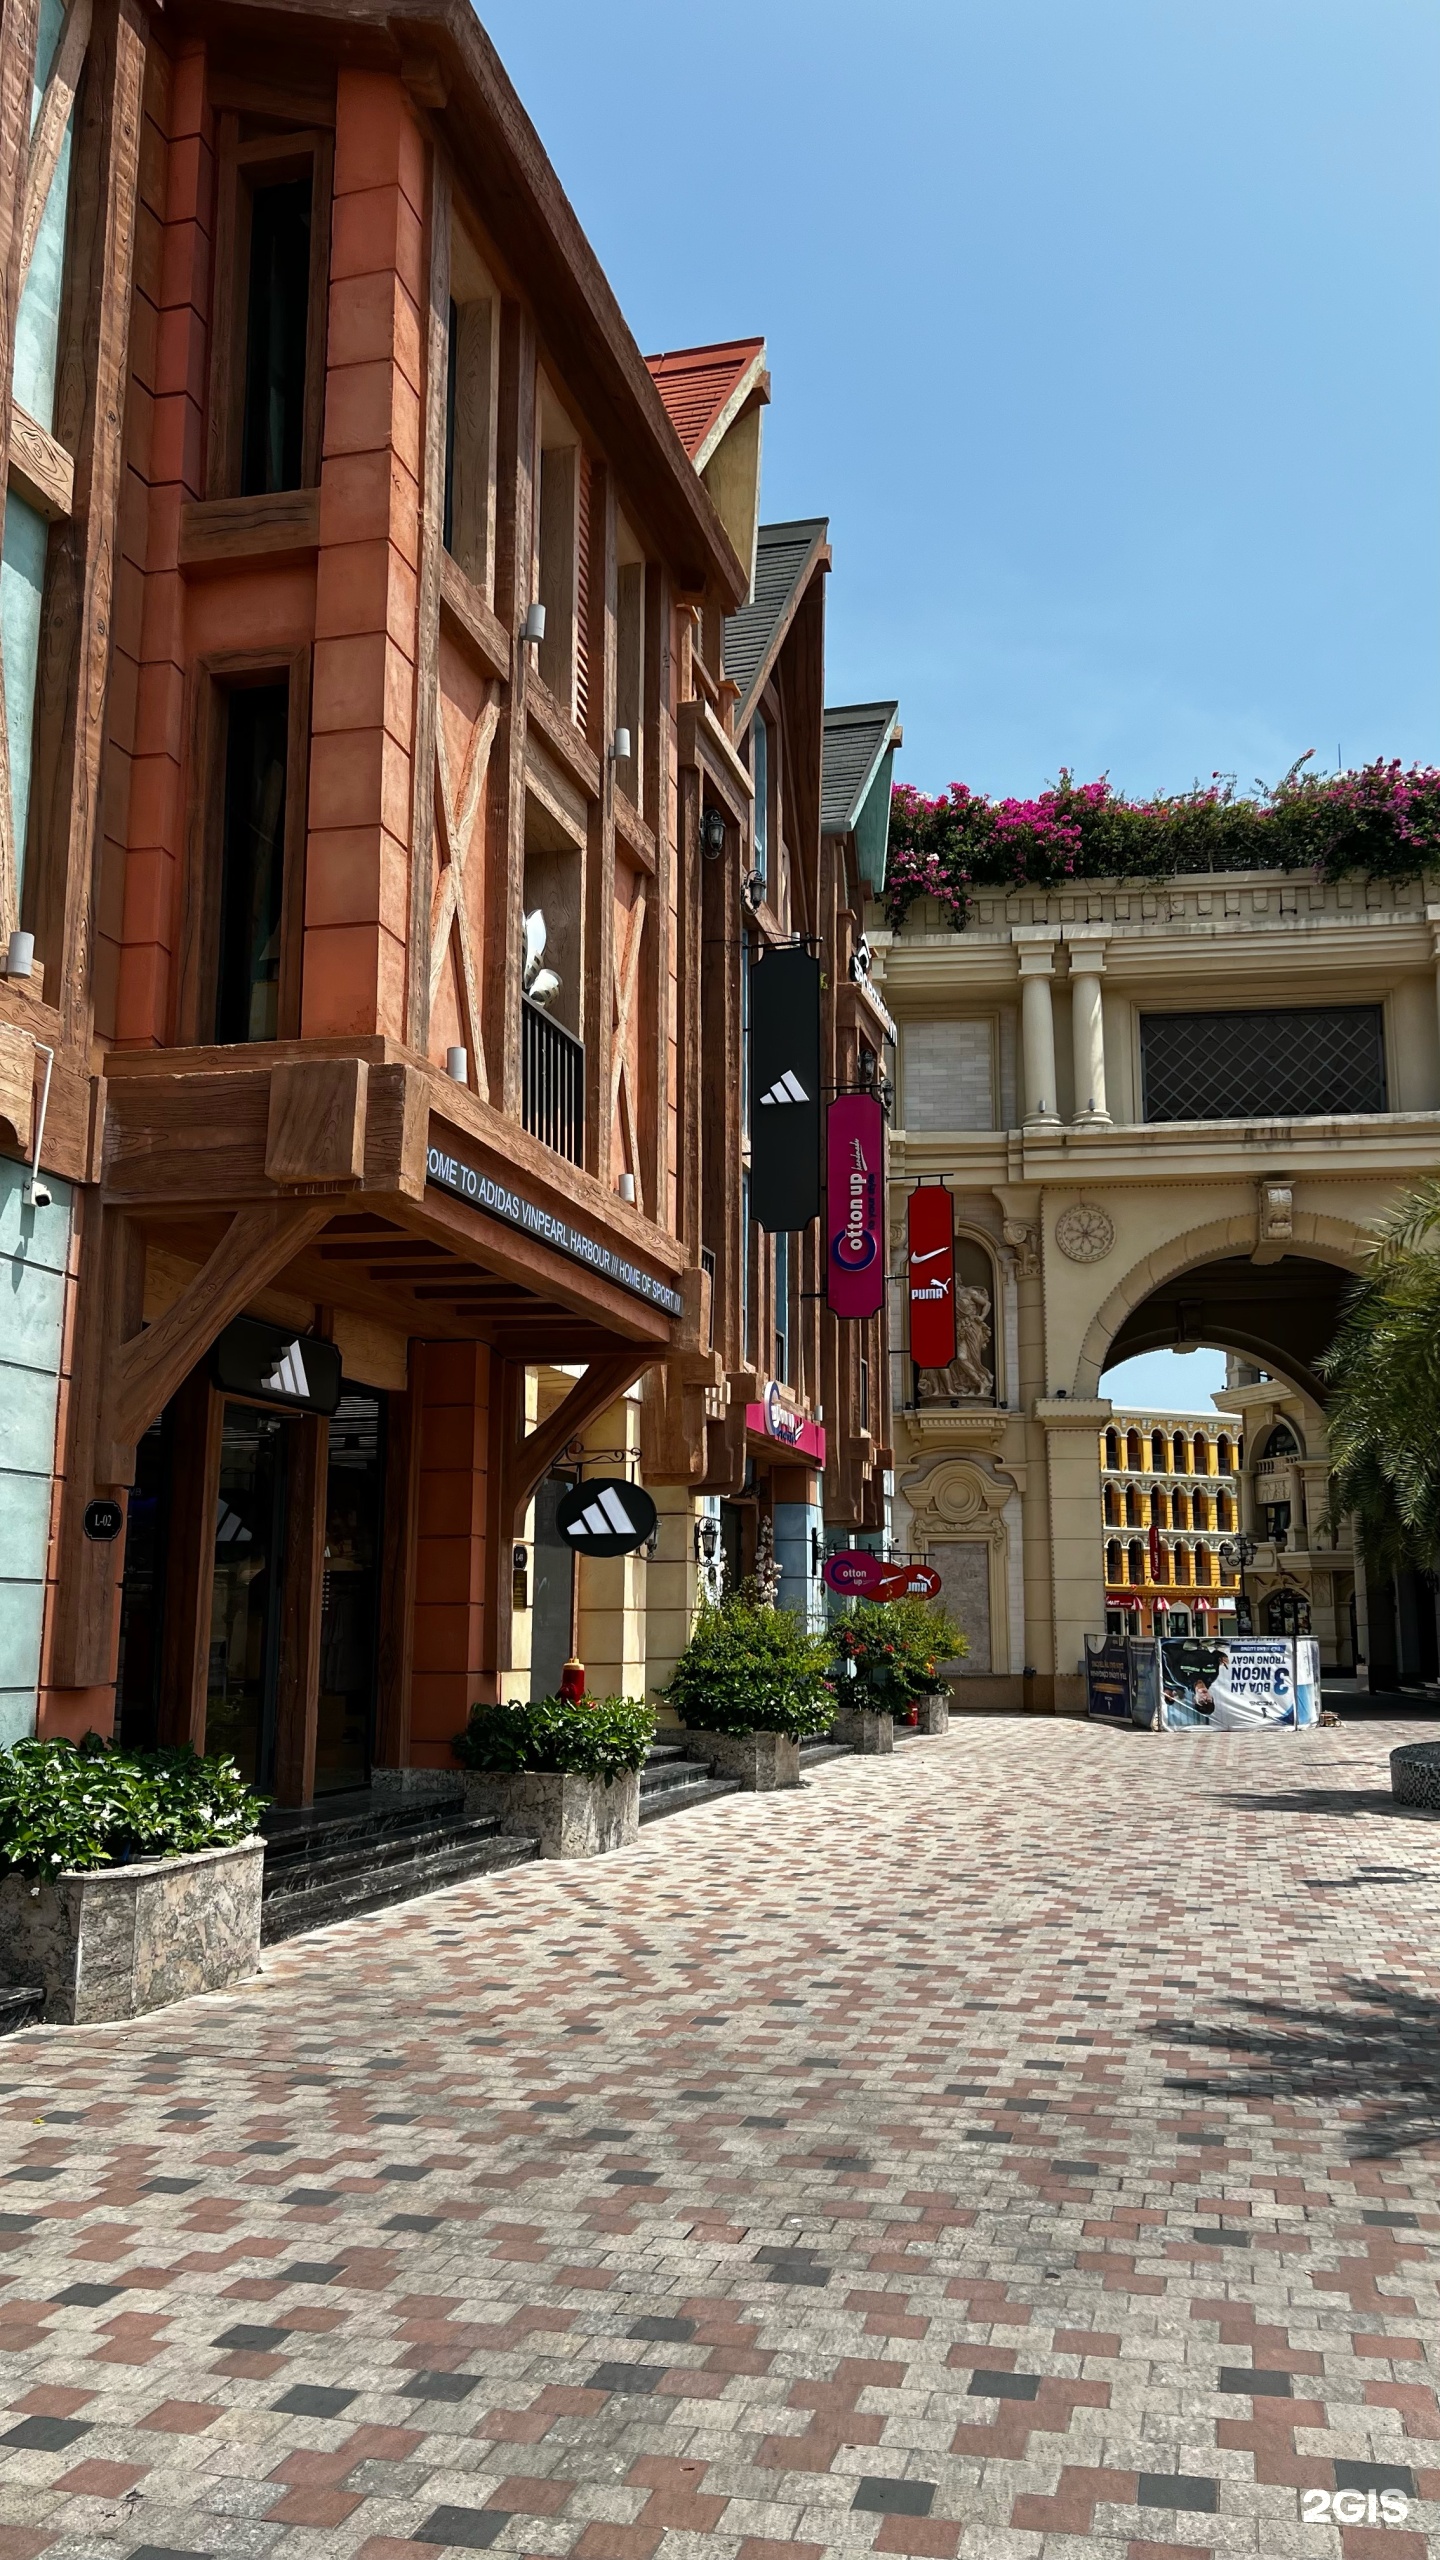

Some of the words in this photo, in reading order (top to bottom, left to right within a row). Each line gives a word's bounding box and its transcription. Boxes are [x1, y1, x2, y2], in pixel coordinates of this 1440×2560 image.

[850, 1173, 867, 1196] up
[426, 1146, 457, 1186] OME
[460, 1164, 477, 1194] TO
[478, 1177, 520, 1219] ADIDAS
[521, 1199, 568, 1247] VINPEARL
[570, 1232, 610, 1272] HARBOUR
[619, 1260, 641, 1290] HOME
[641, 1273, 652, 1294] OF
[652, 1280, 674, 1308] SPORT
[911, 1288, 943, 1300] PUMA
[95, 1514, 112, 1527] L-02
[853, 1579, 863, 1587] up
[907, 1581, 928, 1593] UMA
[1231, 1655, 1255, 1667] NGÀY
[1257, 1655, 1286, 1665] TRONG
[1231, 1666, 1271, 1681] NGON
[1273, 1667, 1290, 1696] 3
[1230, 1682, 1247, 1696] ĂN
[1249, 1682, 1271, 1696] BỮA
